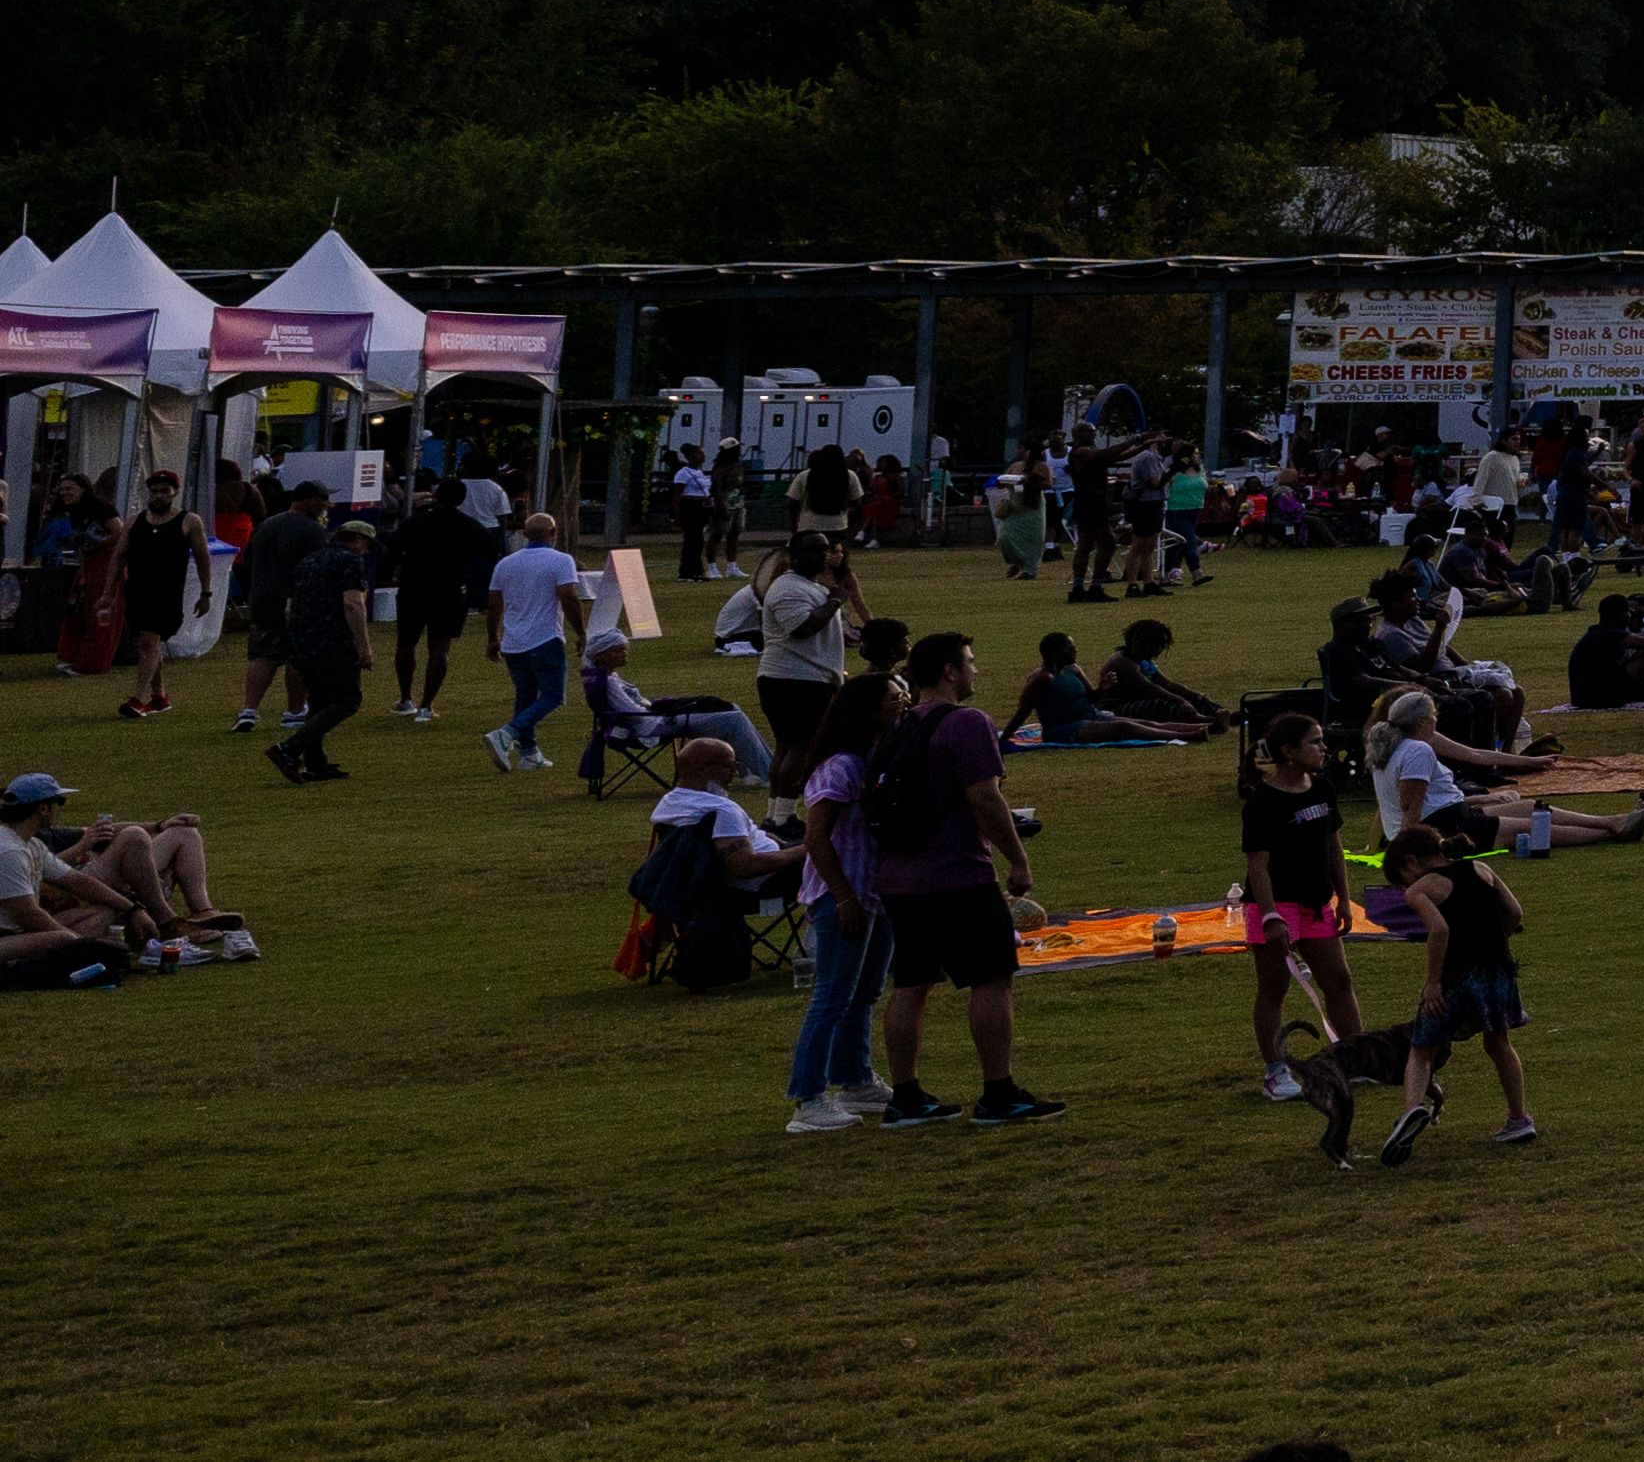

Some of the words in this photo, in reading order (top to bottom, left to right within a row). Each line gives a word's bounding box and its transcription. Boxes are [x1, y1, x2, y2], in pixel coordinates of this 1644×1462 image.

[1363, 288, 1496, 303] GYROS
[1359, 303, 1394, 311] Lamb
[1406, 303, 1438, 311] Steak
[7, 327, 35, 346] ATL
[278, 325, 309, 335] THRIVING
[1553, 327, 1596, 340] Steak
[1602, 327, 1613, 340] &
[440, 333, 497, 350] PERFORMANCE
[498, 335, 546, 352] HYPOTHESIS
[1559, 343, 1607, 355] Polish
[1327, 365, 1406, 380] CHEESE
[1411, 364, 1468, 380] FRIES
[1512, 364, 1568, 379] Chicken
[1572, 364, 1583, 377] &
[1587, 363, 1640, 378] Cheese
[1316, 383, 1410, 394] LOADED
[1414, 383, 1476, 394] FRIES
[1554, 384, 1617, 397] Lemonade
[1619, 384, 1630, 396] &
